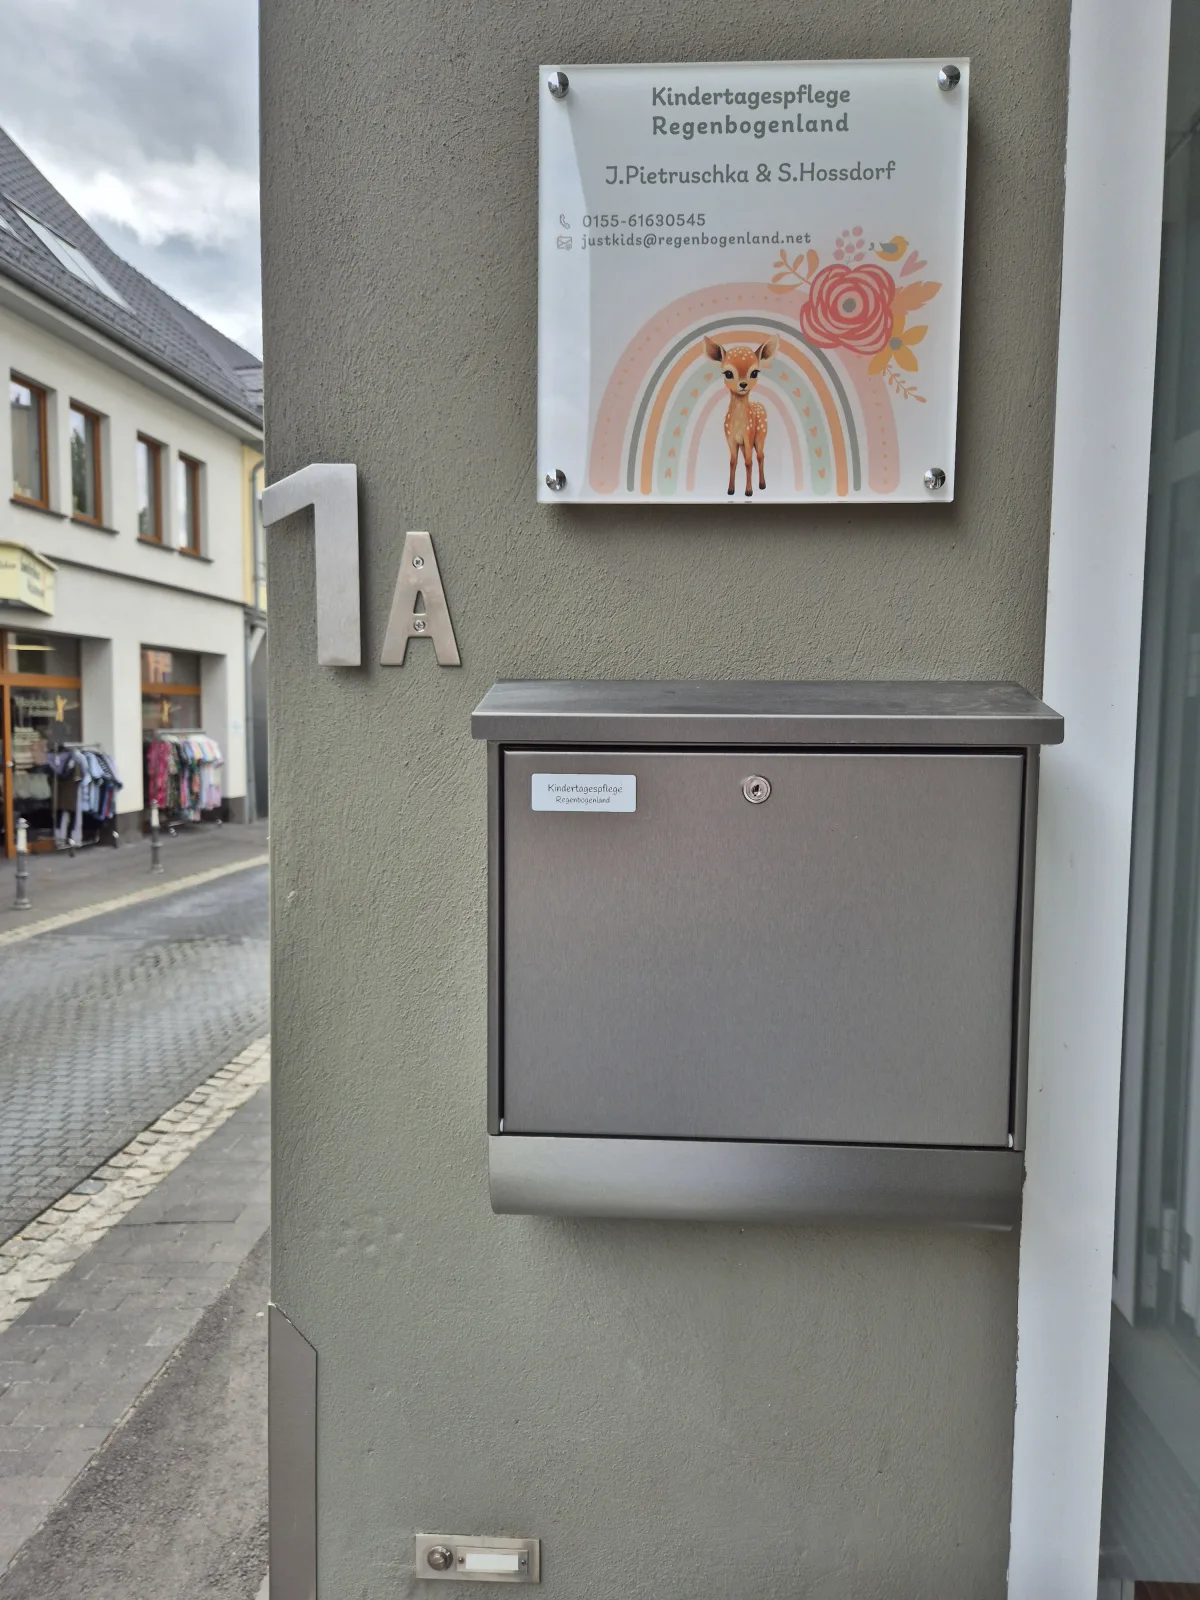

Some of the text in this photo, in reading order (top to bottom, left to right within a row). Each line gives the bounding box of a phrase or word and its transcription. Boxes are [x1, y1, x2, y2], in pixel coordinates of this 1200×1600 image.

[652, 84, 851, 110] Kindertagespflege
[652, 113, 849, 140] Regenbogenland
[605, 161, 897, 186] J.Pietruschka & S.Hossdorf
[582, 213, 706, 228] 0155-61630545
[581, 231, 811, 250] justkids@regenbogenland.net
[547, 783, 623, 795] Kindertagespflege
[555, 796, 611, 805] Regenbogenland
